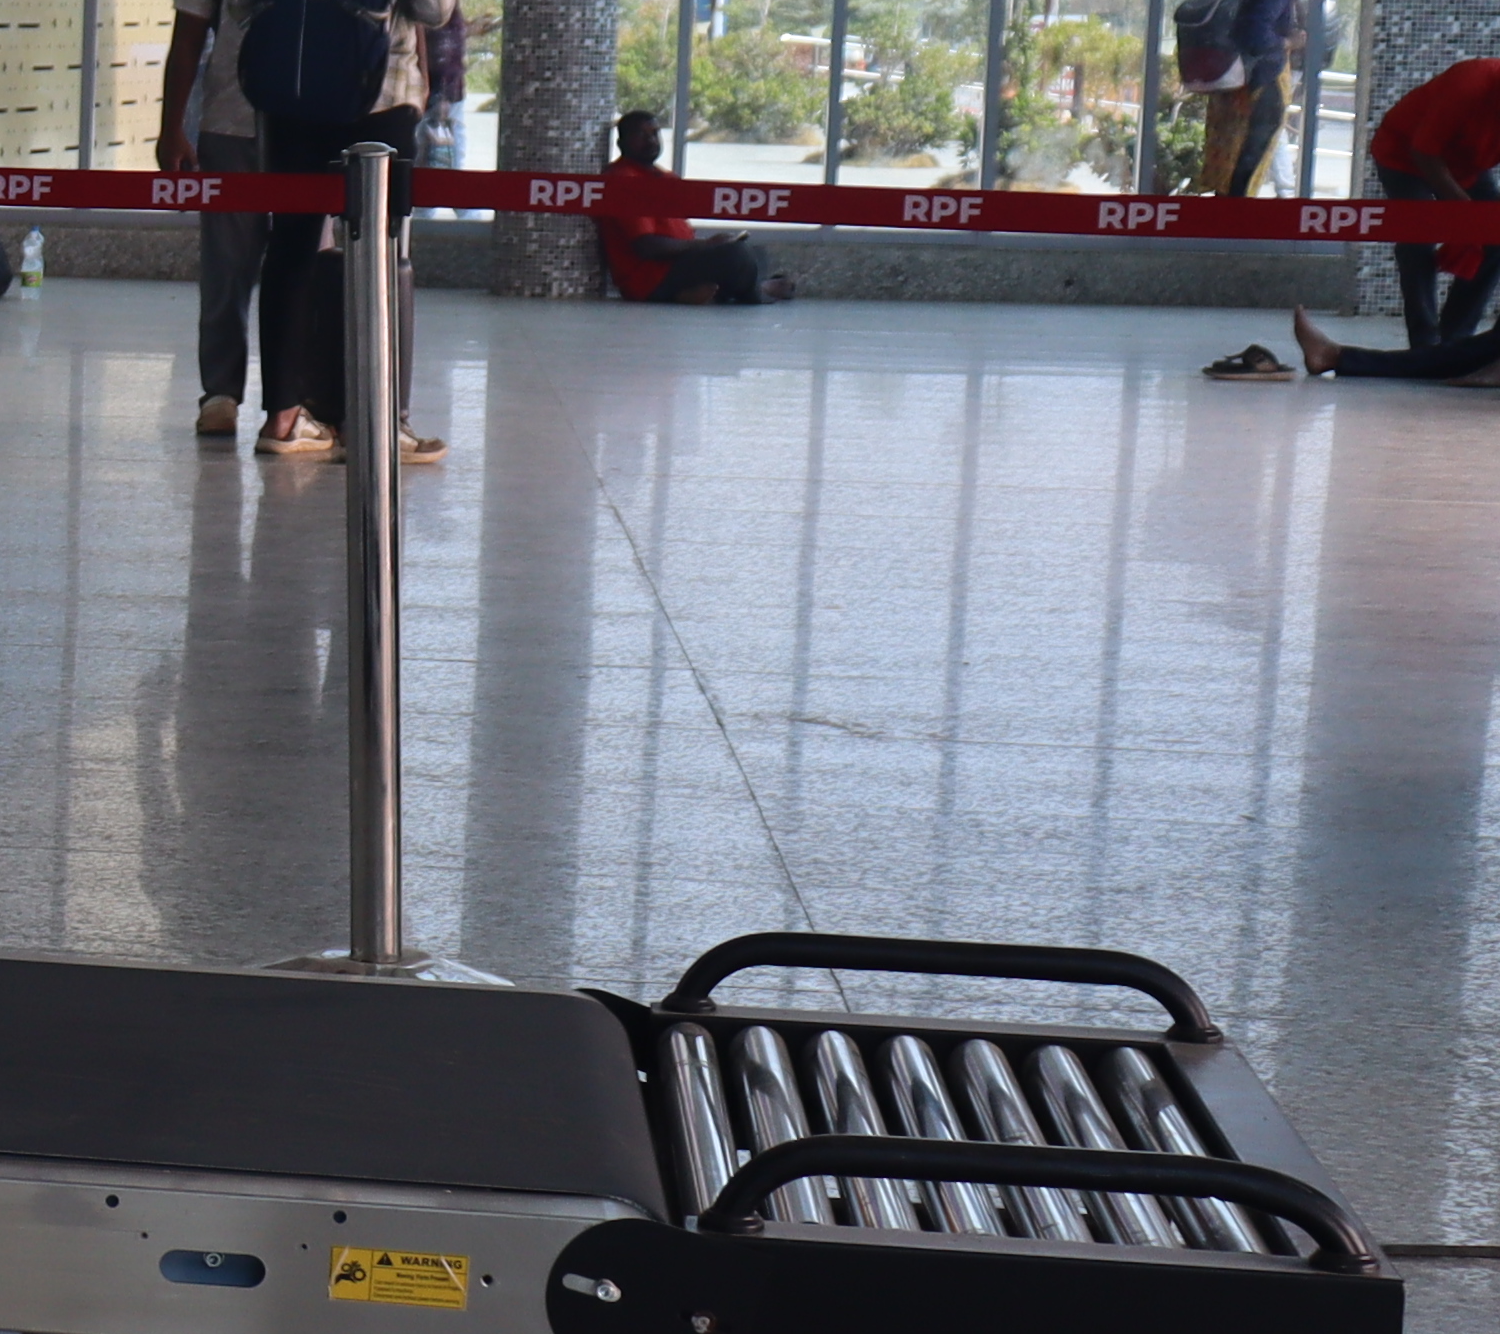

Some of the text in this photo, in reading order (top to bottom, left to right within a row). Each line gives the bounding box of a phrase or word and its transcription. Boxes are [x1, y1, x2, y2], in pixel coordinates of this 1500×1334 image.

[151, 177, 222, 205] RPF
[529, 180, 604, 208] RPF
[712, 187, 791, 215] RPF
[902, 194, 984, 223] RPF
[1098, 201, 1181, 230] RPF
[1300, 206, 1386, 235] RPF
